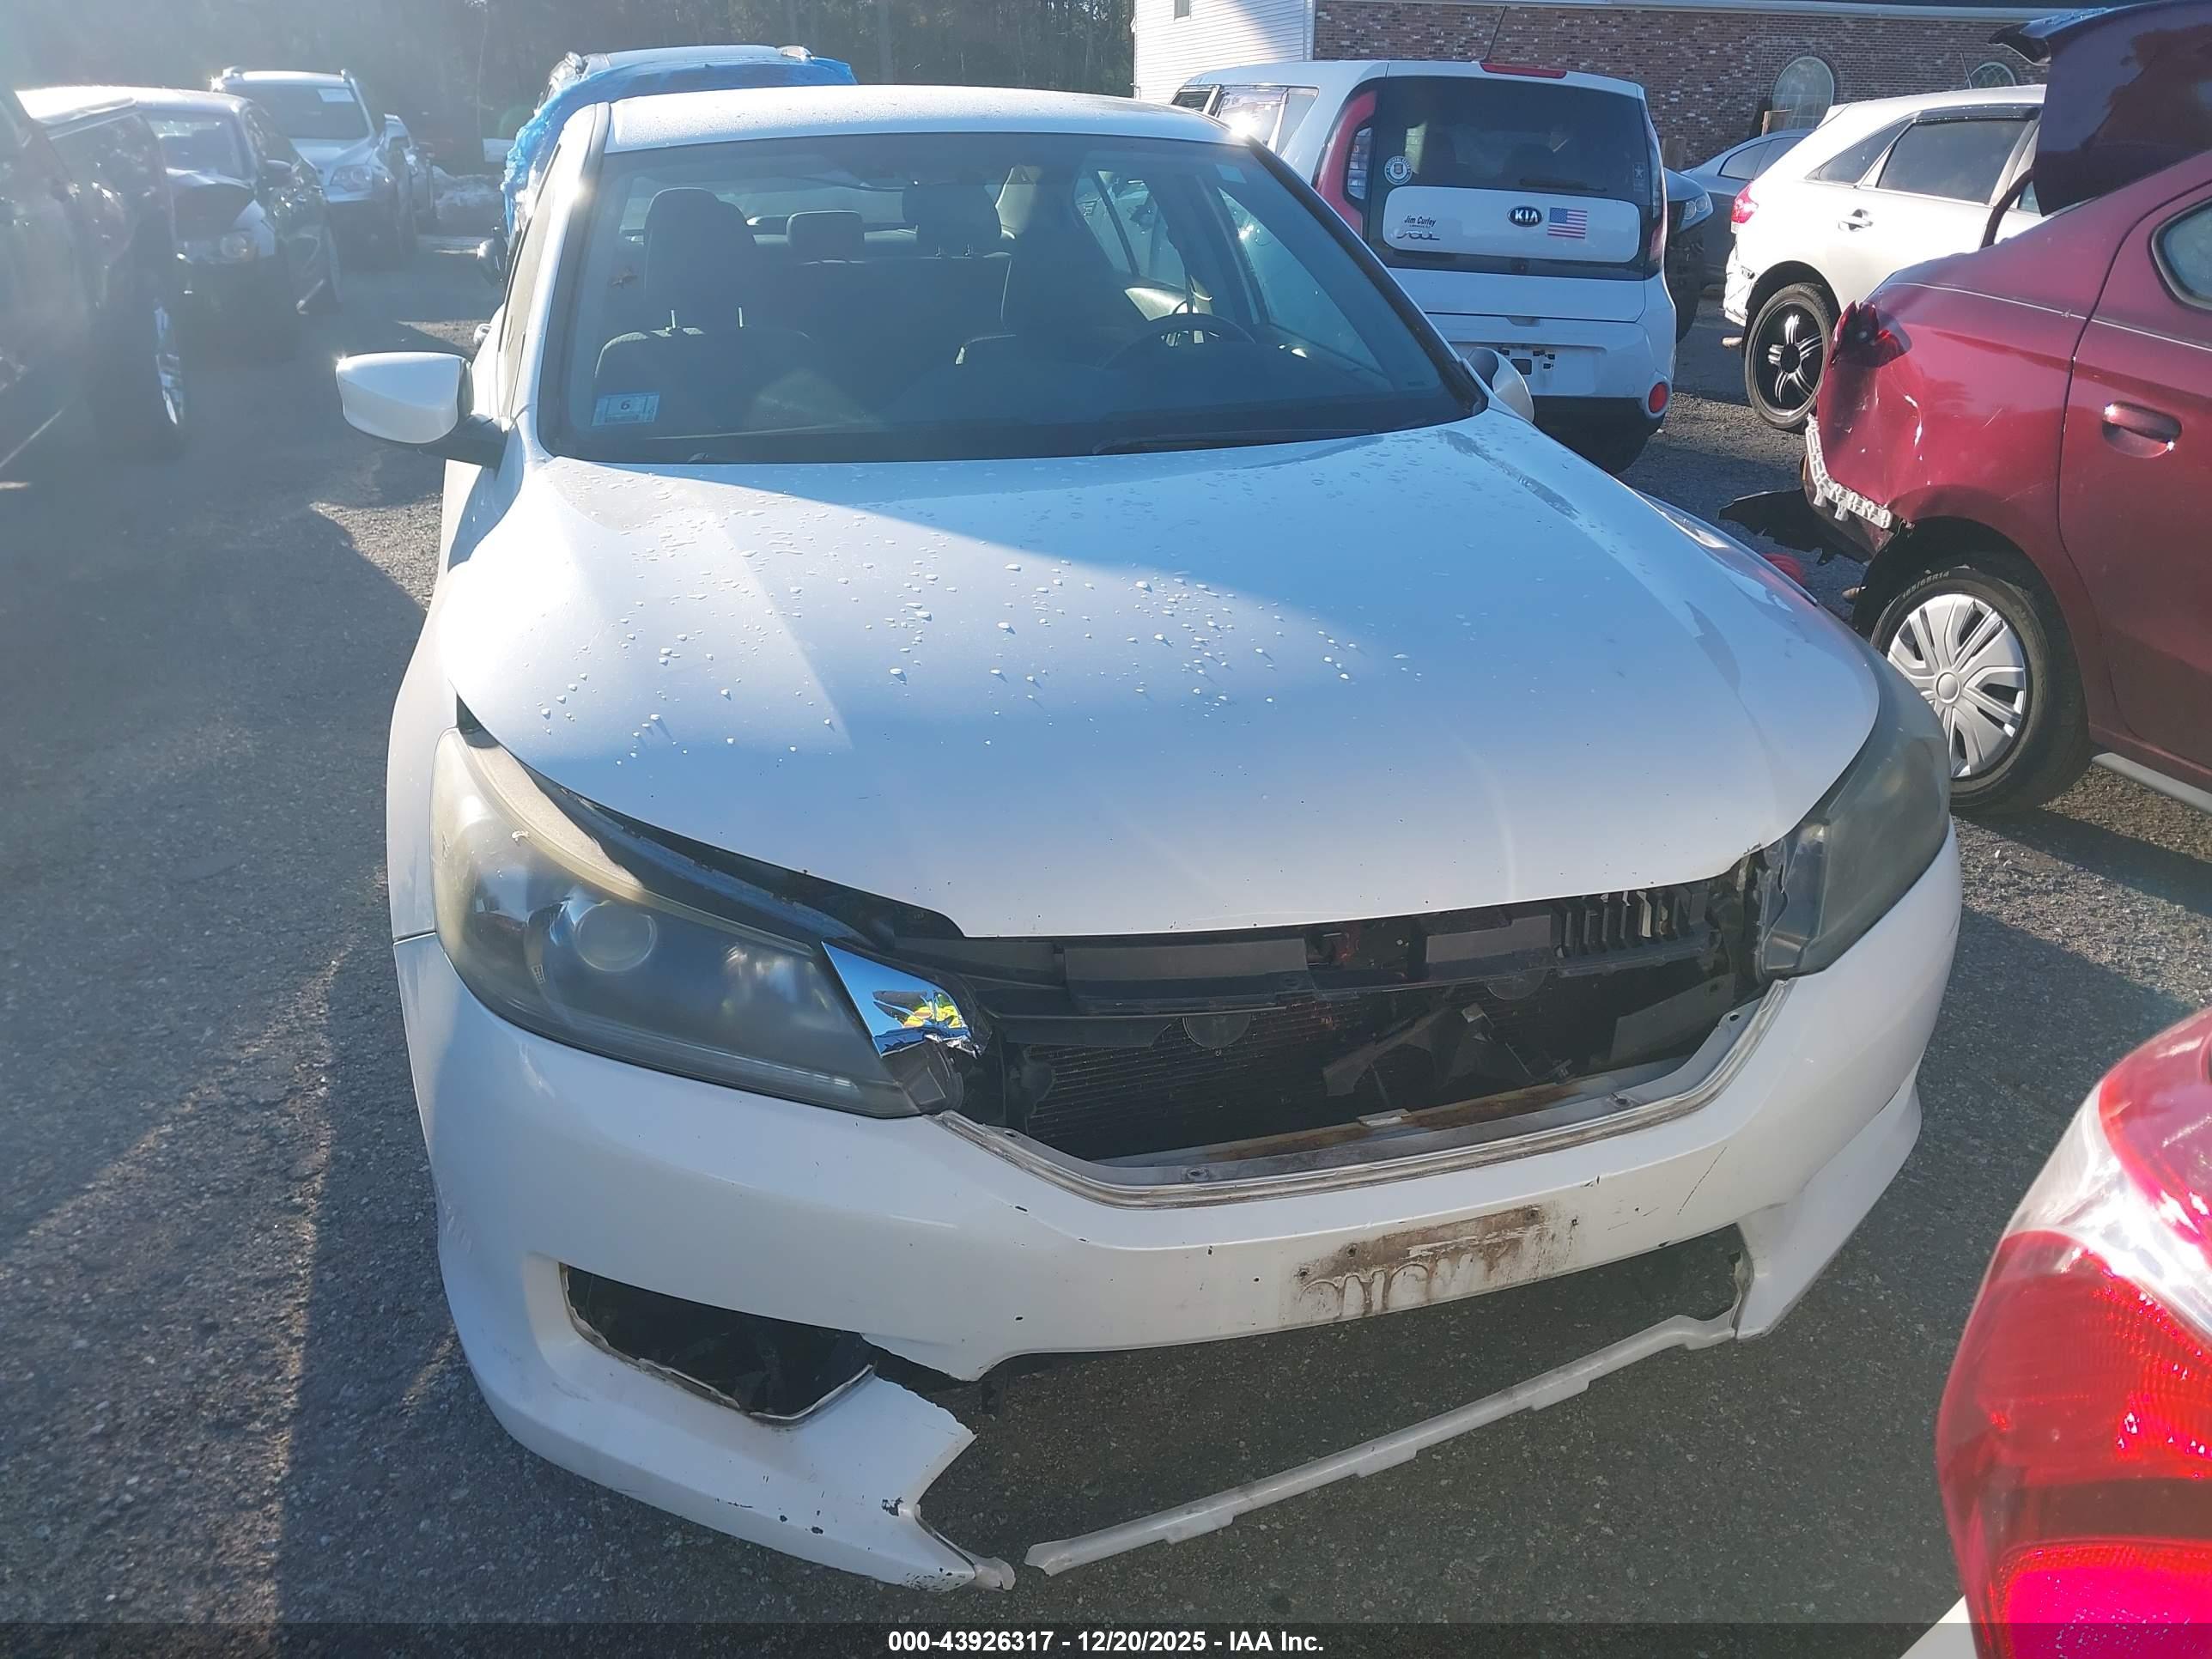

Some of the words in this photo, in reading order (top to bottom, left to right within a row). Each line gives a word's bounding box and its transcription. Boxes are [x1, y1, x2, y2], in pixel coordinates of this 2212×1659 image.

[1404, 215, 1416, 224] Jim
[1417, 216, 1437, 228] Curley
[1515, 210, 1538, 222] KIA
[621, 399, 631, 410] 6
